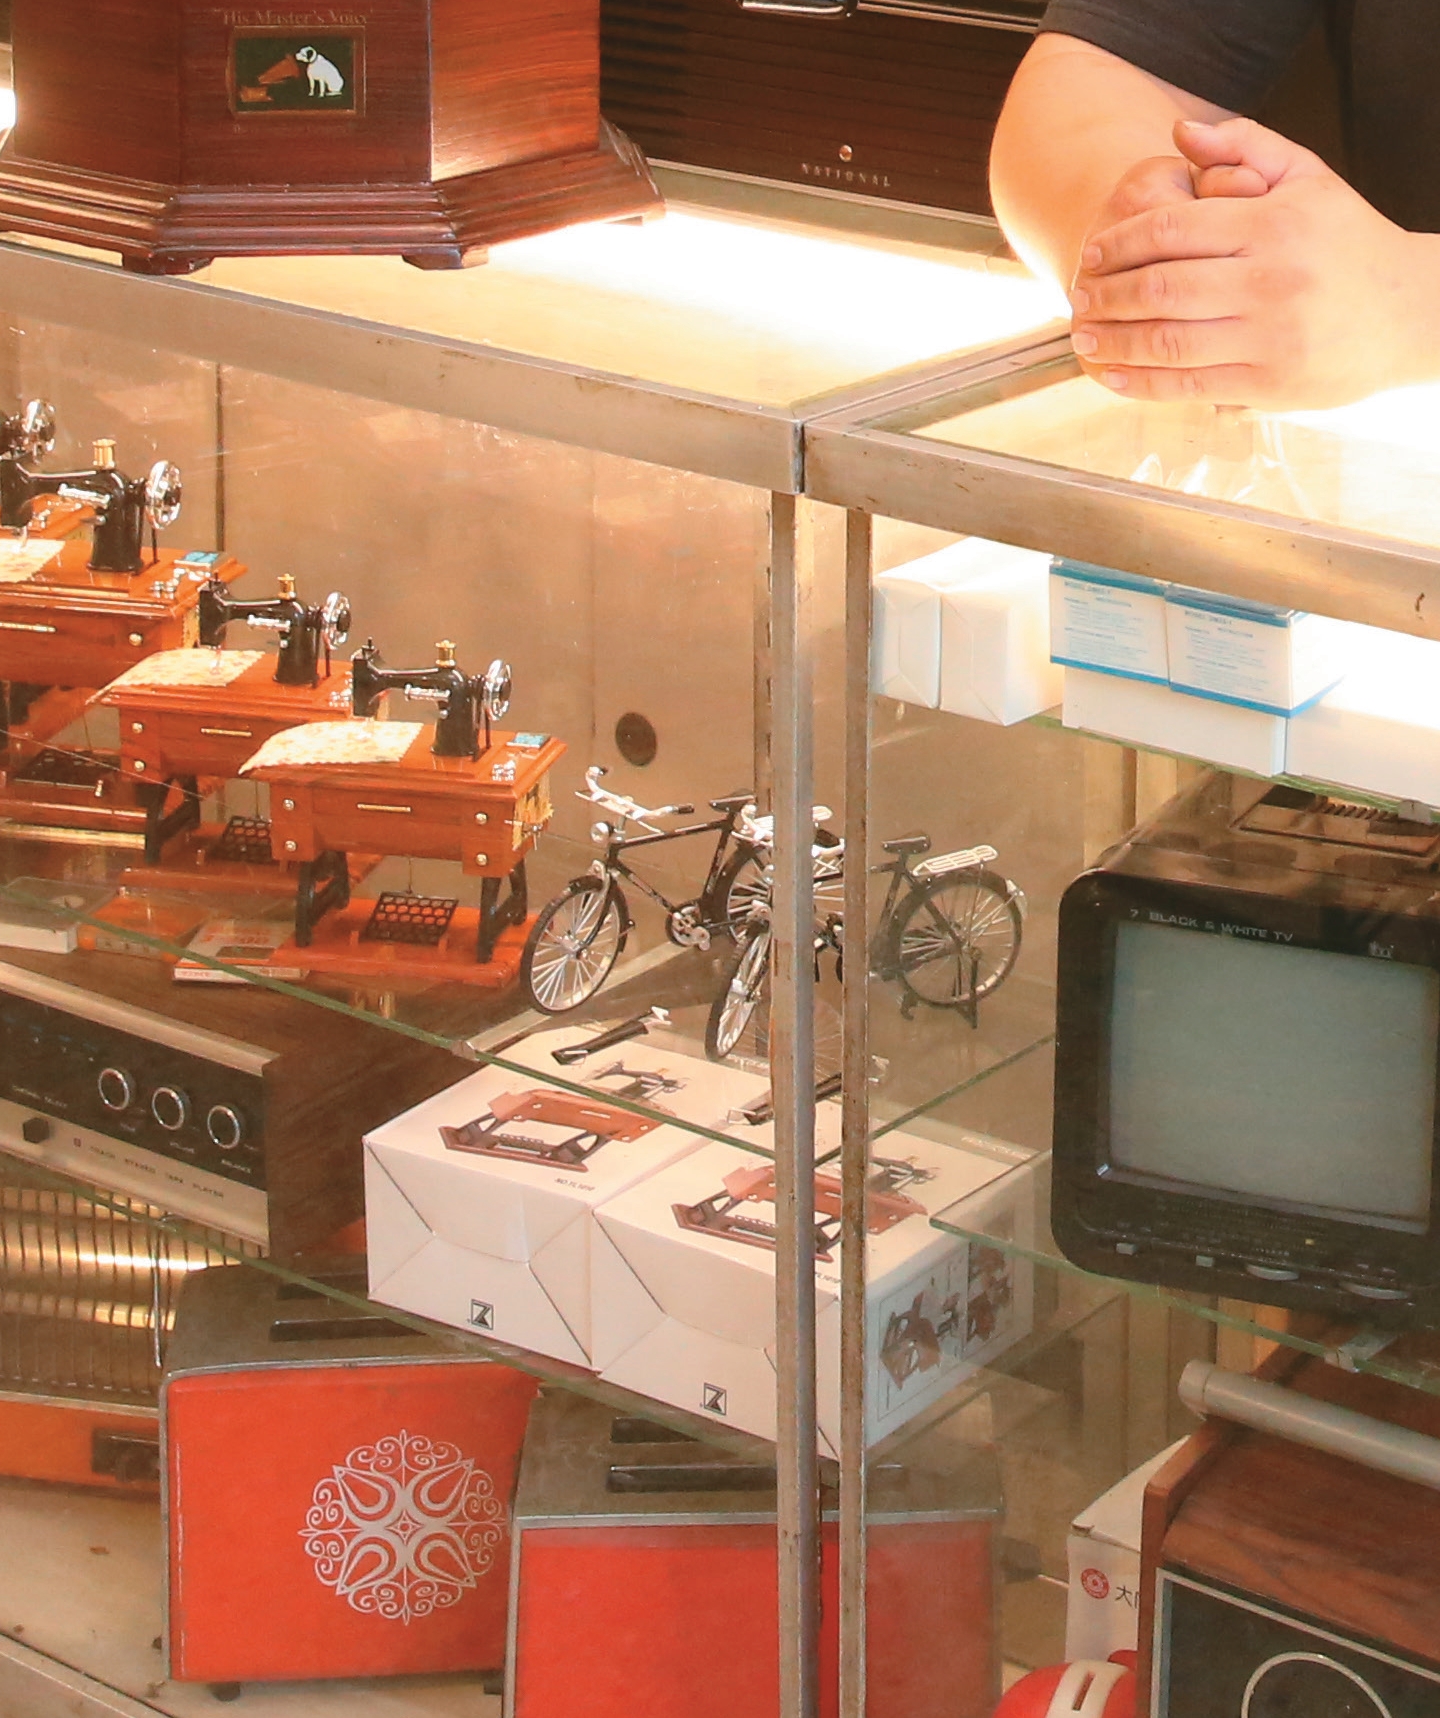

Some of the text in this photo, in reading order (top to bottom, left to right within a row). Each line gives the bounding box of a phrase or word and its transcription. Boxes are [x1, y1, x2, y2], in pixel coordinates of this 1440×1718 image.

[801, 162, 891, 188] NATIONAL
[1149, 912, 1198, 928] BLACK
[1220, 922, 1269, 939] WHITE
[1273, 931, 1295, 942] TV
[192, 1183, 225, 1199] PLAYER
